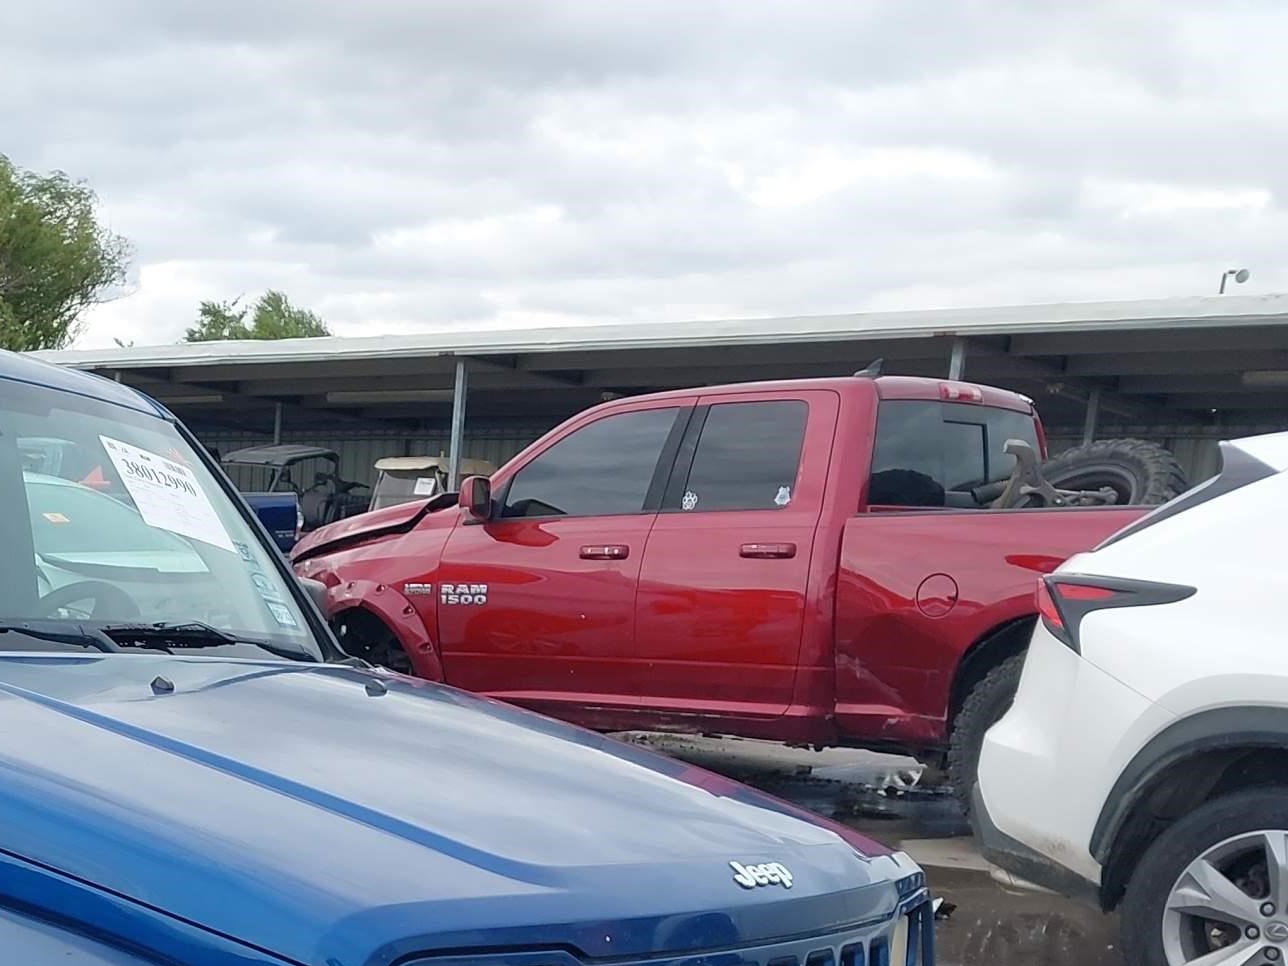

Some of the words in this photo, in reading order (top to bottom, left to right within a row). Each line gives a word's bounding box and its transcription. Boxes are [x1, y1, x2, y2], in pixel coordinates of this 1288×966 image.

[121, 458, 197, 497] 38012990
[440, 584, 488, 594] RAM
[440, 594, 487, 604] 1500
[728, 861, 793, 889] Jeep
